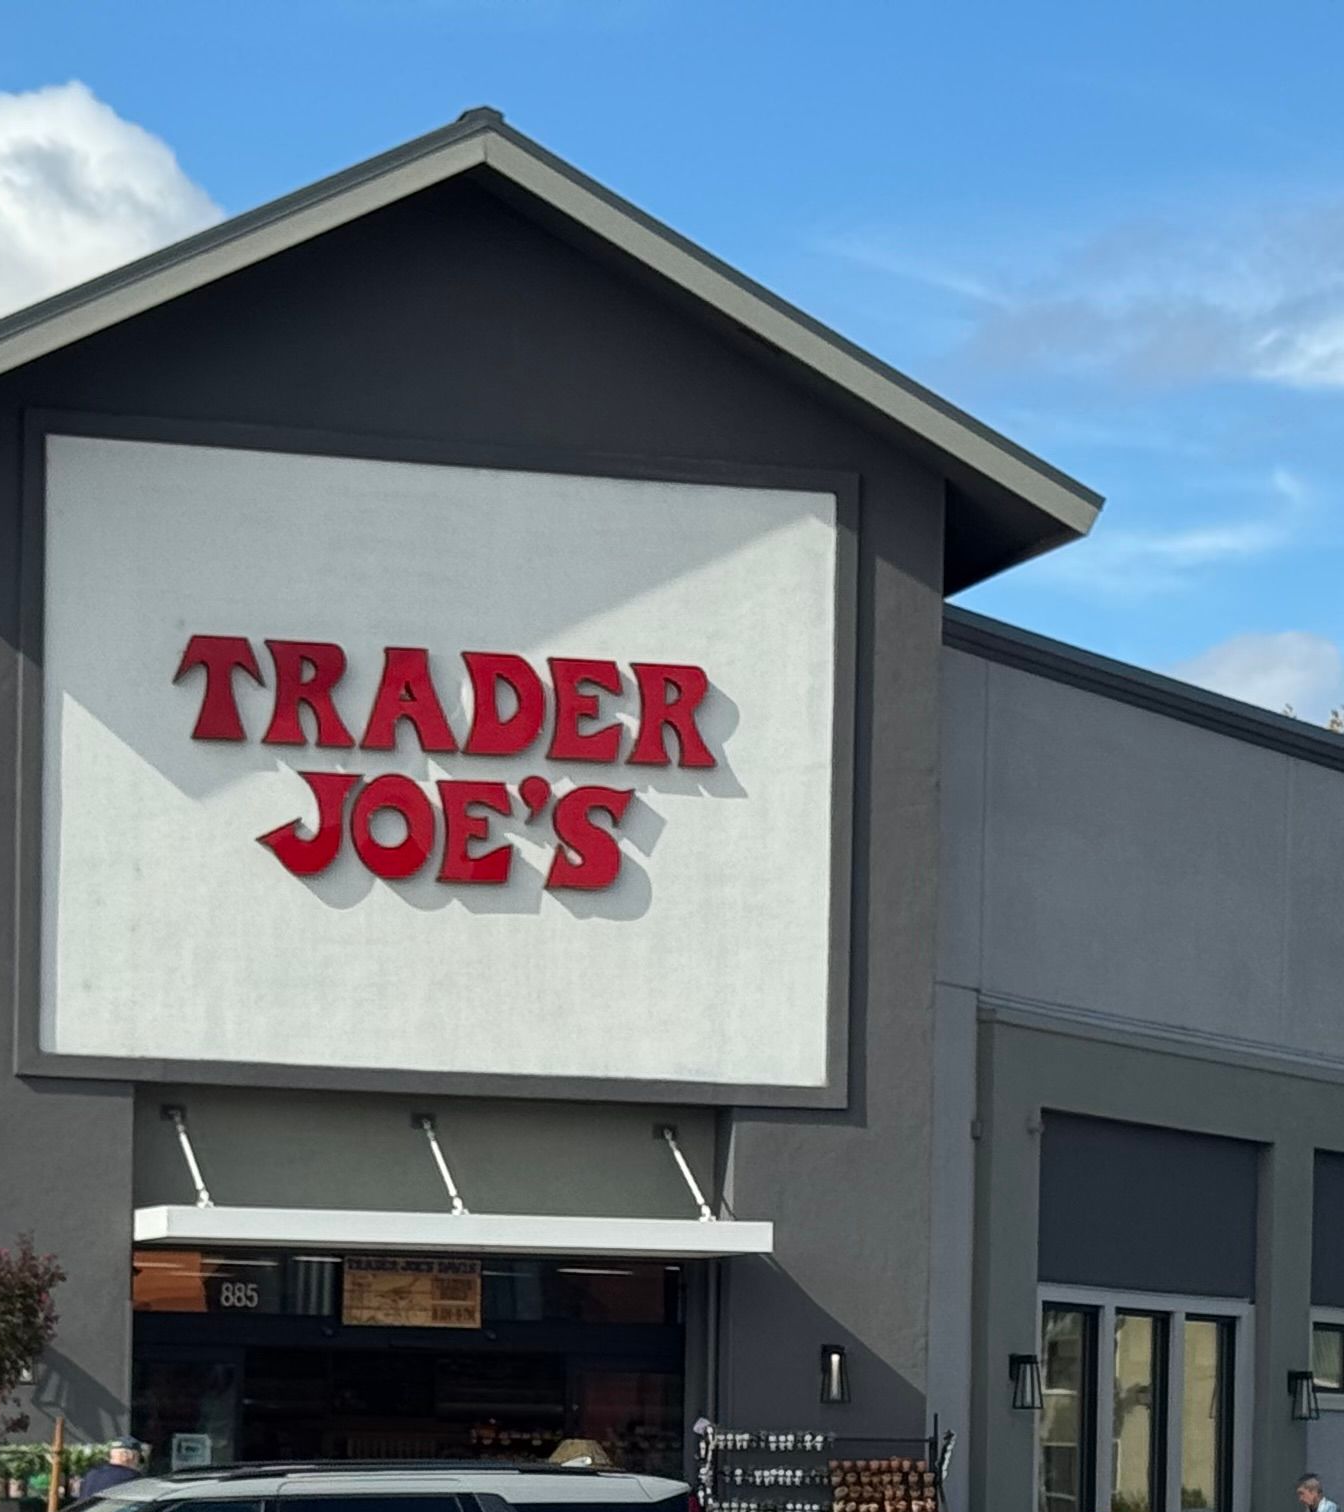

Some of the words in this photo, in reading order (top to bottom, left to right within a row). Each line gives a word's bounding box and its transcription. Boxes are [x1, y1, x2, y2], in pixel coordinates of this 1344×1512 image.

[172, 634, 716, 768] TRADER
[256, 770, 636, 891] JOE'S
[220, 1282, 259, 1308] 885
